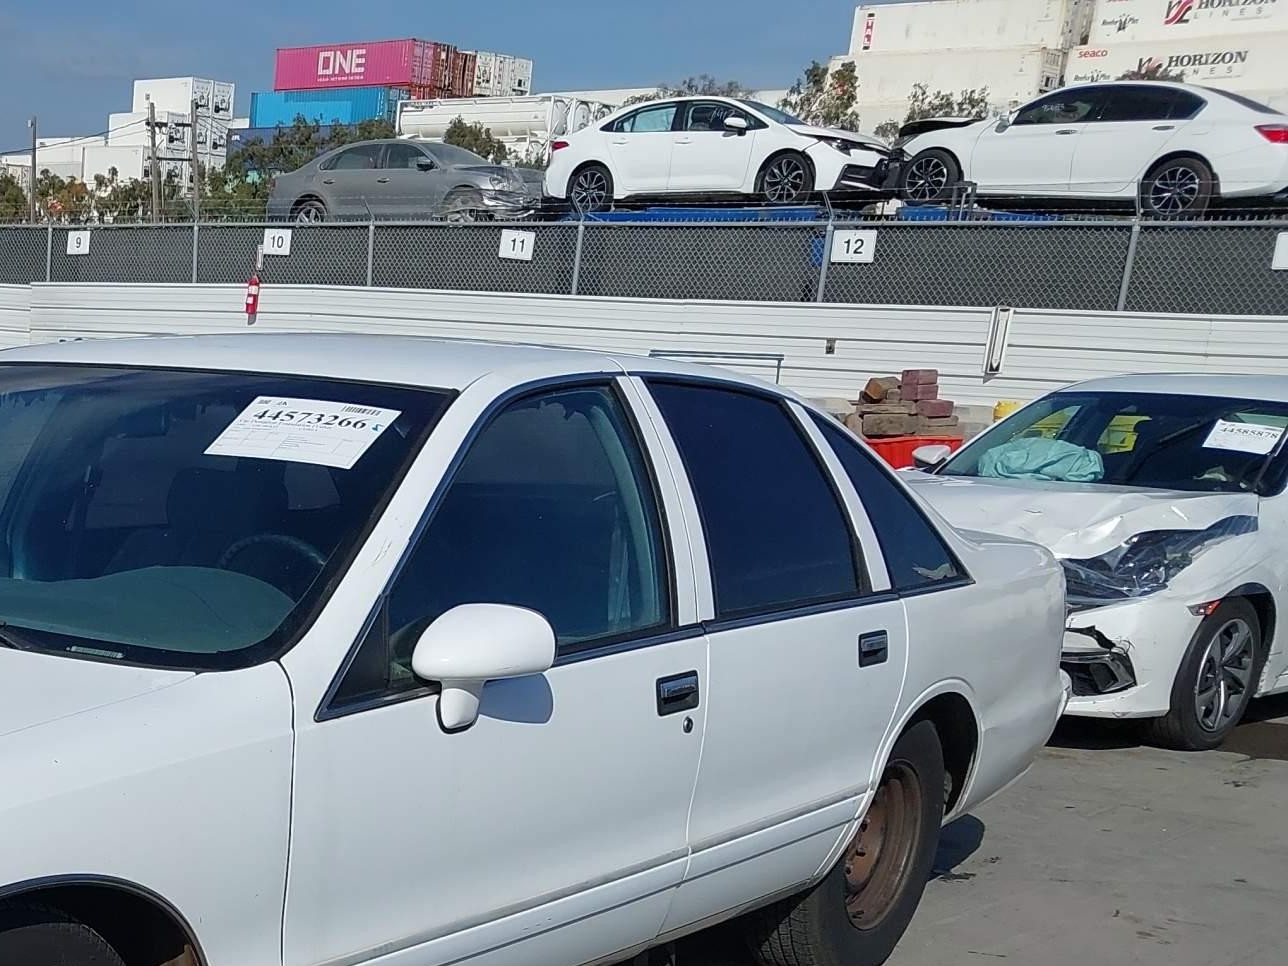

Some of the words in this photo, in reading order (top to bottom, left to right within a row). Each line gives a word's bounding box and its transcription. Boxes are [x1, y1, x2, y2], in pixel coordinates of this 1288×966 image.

[1078, 49, 1108, 59] seaco
[1167, 50, 1249, 68] HORIZON
[317, 49, 366, 75] ONE
[75, 237, 82, 249] 9
[270, 235, 284, 249] 10
[509, 238, 526, 253] 11
[843, 239, 864, 255] 12
[253, 409, 368, 430] 44573266
